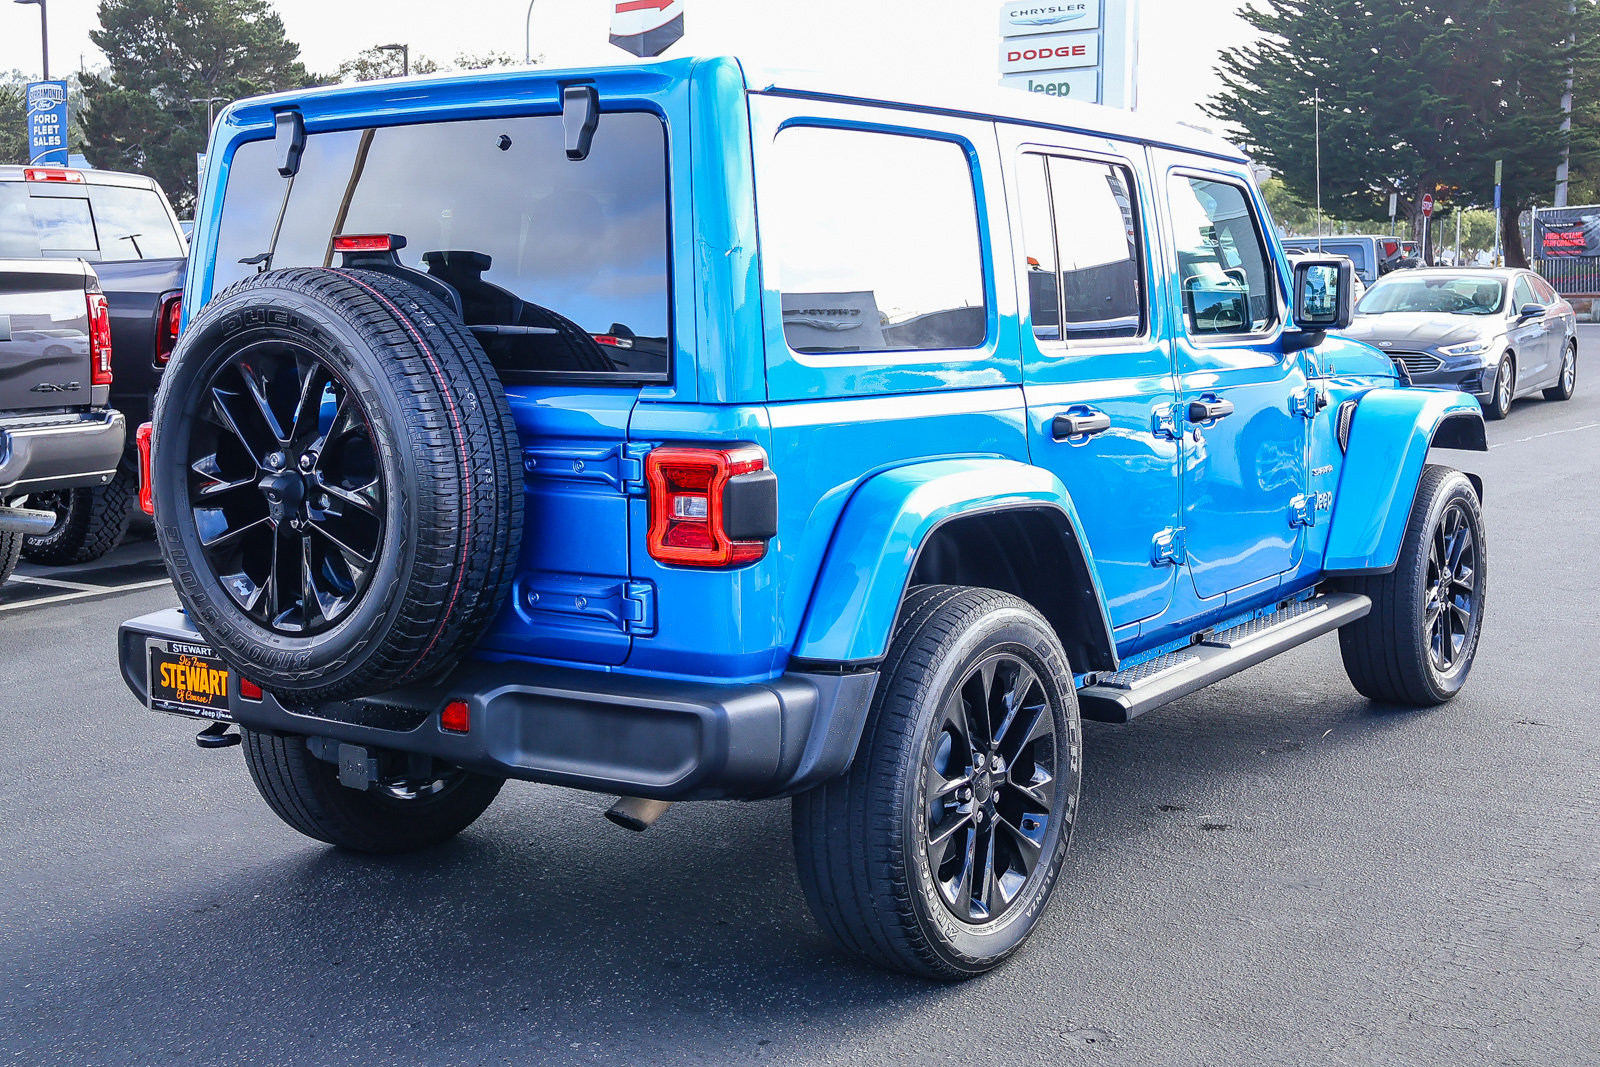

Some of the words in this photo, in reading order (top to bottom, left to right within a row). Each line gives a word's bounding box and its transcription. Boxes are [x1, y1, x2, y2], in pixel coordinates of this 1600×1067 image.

[1010, 3, 1086, 17] CHRYSLER
[1007, 45, 1086, 62] DODGE
[1028, 80, 1070, 97] Jeep
[34, 114, 58, 125] FORD
[33, 125, 60, 136] FLEET
[33, 136, 61, 146] SALES
[220, 308, 354, 372] DUELER
[1314, 490, 1333, 512] Jeep
[162, 524, 314, 672] BRIDGESTONE
[172, 644, 212, 656] STEWART
[160, 661, 229, 697] STEWART
[176, 689, 186, 703] Of
[201, 708, 216, 718] Jeep
[1034, 640, 1078, 773] DUELER
[1025, 864, 1054, 917] ALENZA
